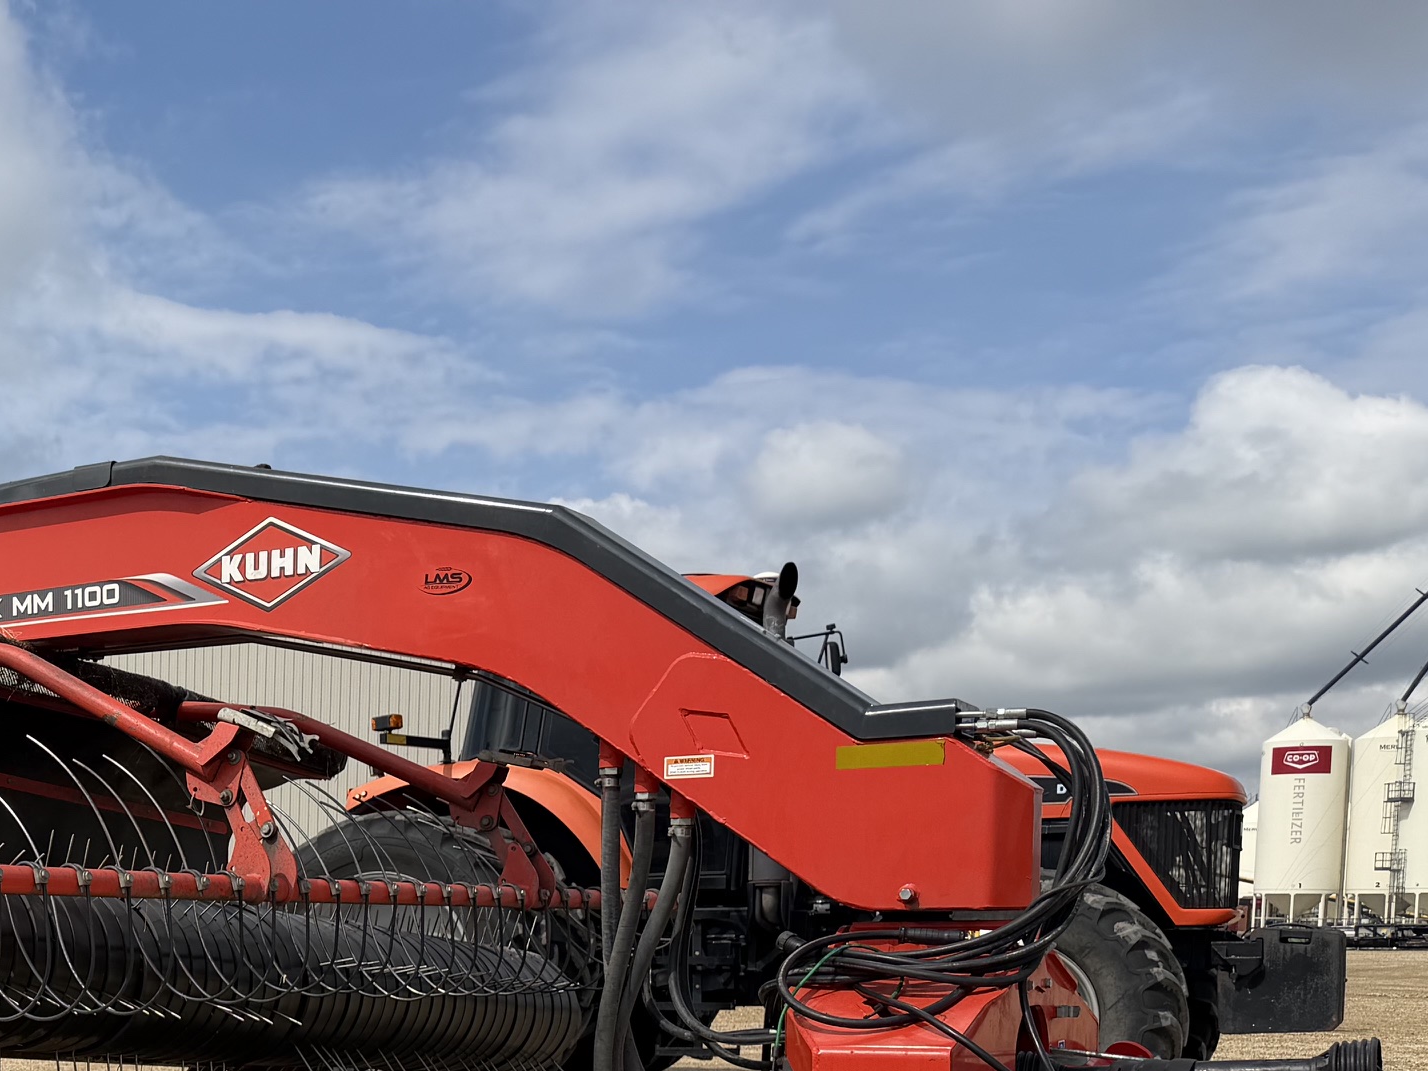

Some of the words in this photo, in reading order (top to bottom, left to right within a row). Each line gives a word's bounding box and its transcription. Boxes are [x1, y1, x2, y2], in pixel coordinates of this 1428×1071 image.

[221, 544, 321, 584] KUHN
[425, 573, 463, 585] LMS
[12, 592, 54, 617] MM
[64, 583, 120, 610] 1100
[1286, 754, 1316, 762] CO-OP
[1290, 778, 1305, 844] FERTILIZER
